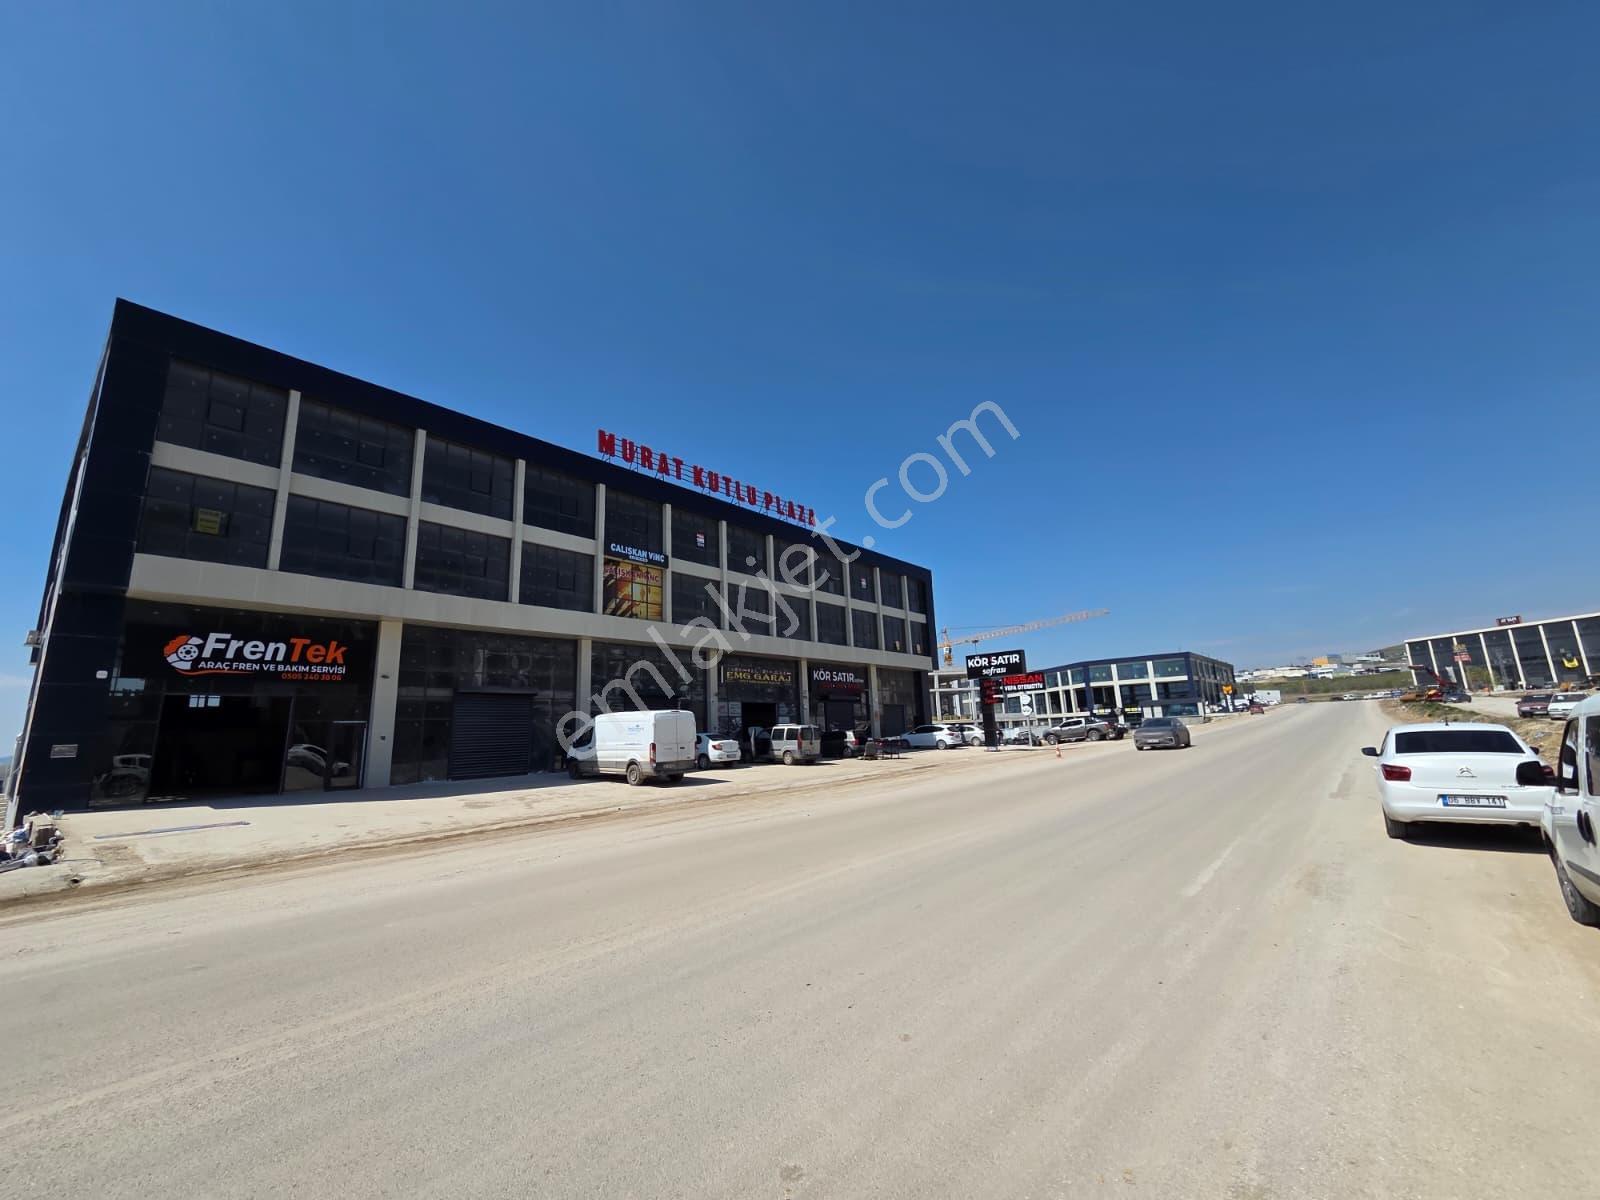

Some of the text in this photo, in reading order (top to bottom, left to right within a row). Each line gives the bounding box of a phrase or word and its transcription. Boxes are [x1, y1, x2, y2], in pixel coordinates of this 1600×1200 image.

[598, 429, 816, 527] MURAT KUTLU PLAZA
[201, 632, 347, 664] FrenTek
[198, 661, 346, 674] ARAÇ FREN VE BAKIM SERVİSİ
[968, 655, 1020, 669] KÖR SATIR
[754, 673, 792, 682] GARAJ
[813, 667, 855, 683] KÖR SATIR
[1003, 673, 1043, 686] NISSAN
